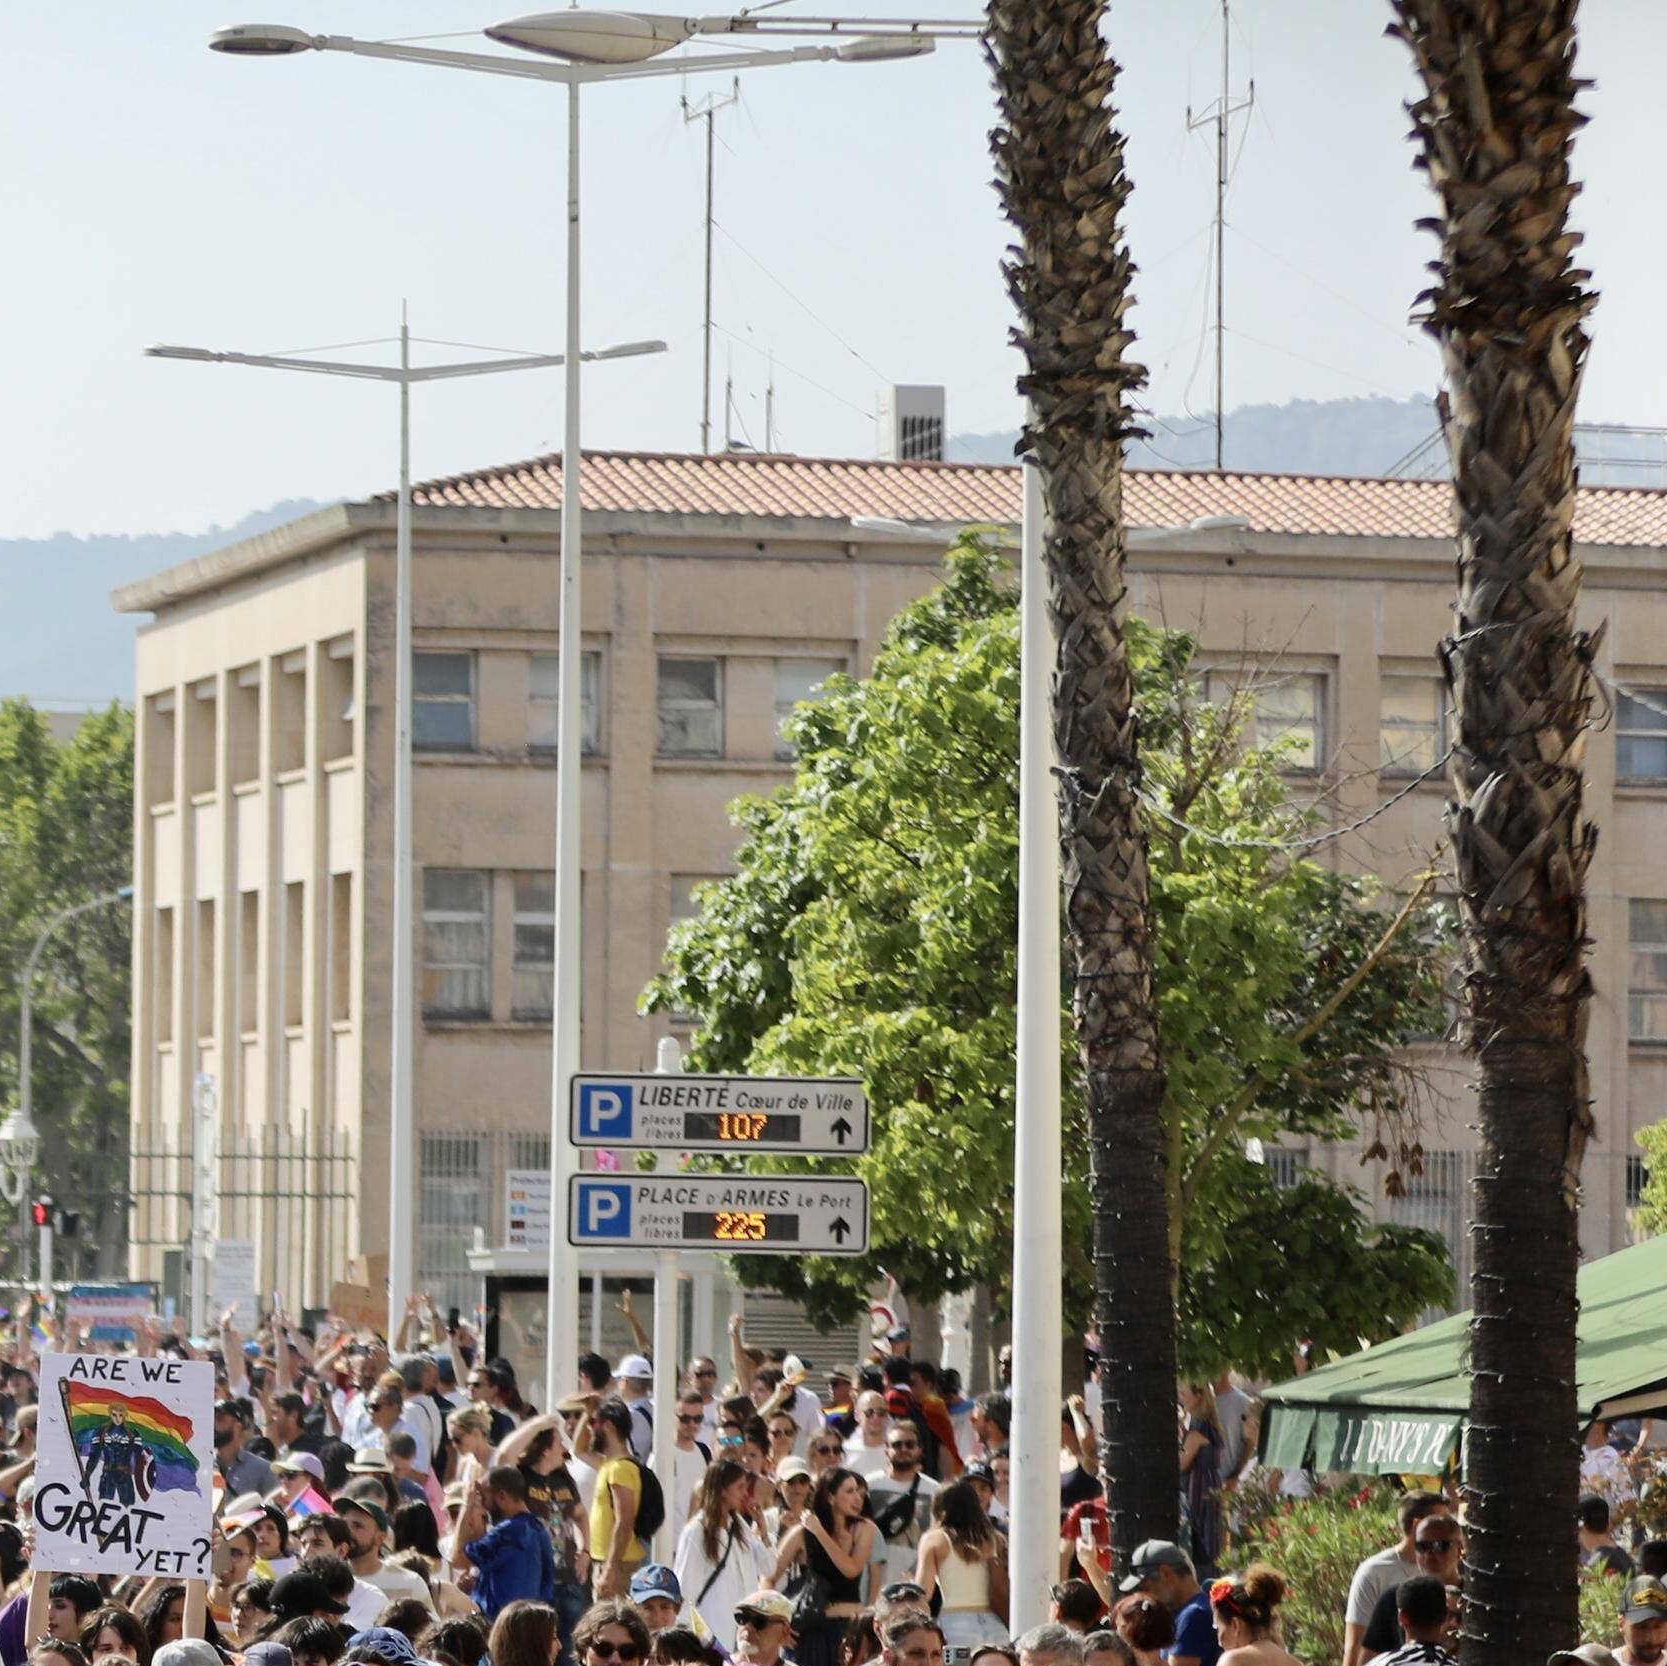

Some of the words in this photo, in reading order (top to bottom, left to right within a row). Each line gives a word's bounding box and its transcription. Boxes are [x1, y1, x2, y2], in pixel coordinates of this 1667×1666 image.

[639, 1081, 731, 1108] LIBERTÉ
[736, 1093, 782, 1109] Cœur
[788, 1093, 809, 1109] de
[817, 1093, 854, 1110] Ville
[641, 1114, 682, 1127] places
[646, 1128, 682, 1139] libres
[718, 1113, 768, 1140] 107
[638, 1187, 700, 1206] PLACE
[797, 1194, 814, 1207] Le
[819, 1194, 851, 1208] Port
[640, 1213, 681, 1226] places
[714, 1212, 767, 1240] 225
[644, 1227, 681, 1239] libres
[69, 1357, 129, 1381] ARE
[141, 1361, 183, 1383] WE
[34, 1482, 165, 1554] GREAT
[135, 1537, 212, 1574] YET?
